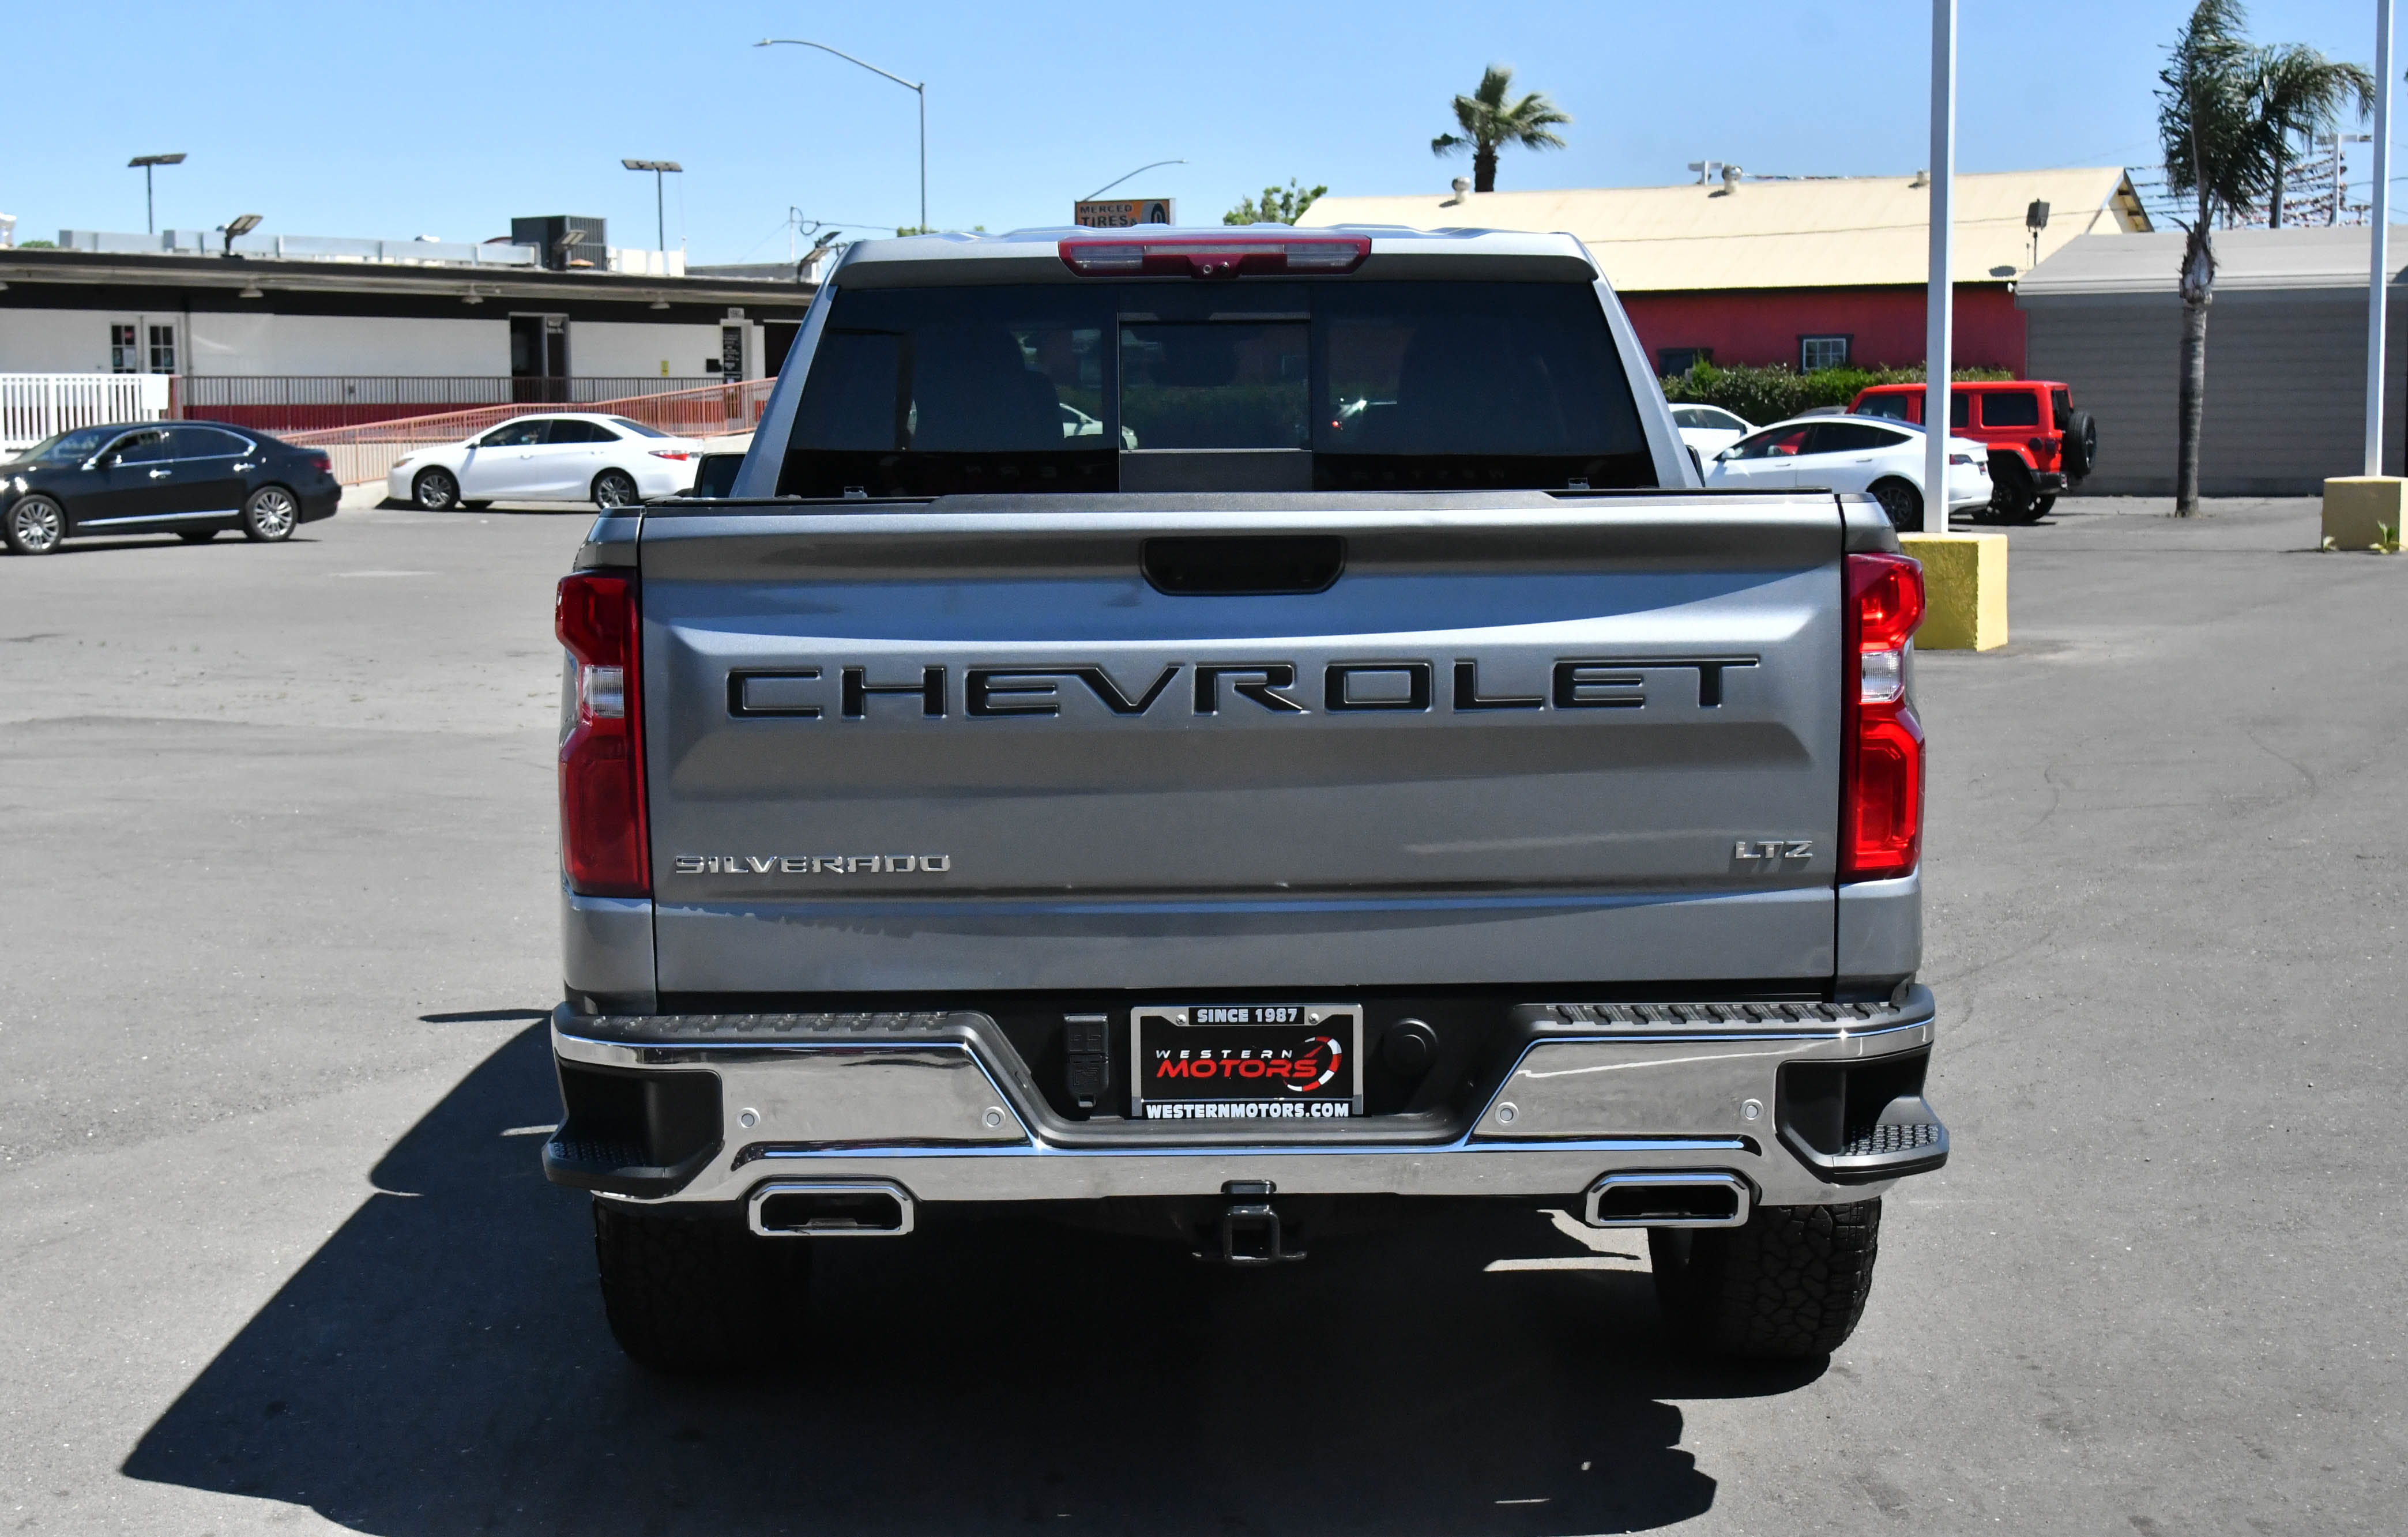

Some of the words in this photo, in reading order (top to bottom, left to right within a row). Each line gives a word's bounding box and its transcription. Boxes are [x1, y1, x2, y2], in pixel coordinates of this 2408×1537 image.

[1079, 204, 1133, 213] MERCED
[1081, 216, 1128, 228] TIRES
[726, 654, 1760, 719] CHEVROLET
[1735, 841, 1813, 859] LTZ
[675, 854, 951, 874] SILVERADO
[1197, 1008, 1249, 1023] SINCE
[1255, 1008, 1298, 1023] 1987
[1156, 1049, 1293, 1059] WESTERN
[1156, 1058, 1318, 1078] MOTORS
[1146, 1103, 1349, 1120] WESTERNMOTORS.COM
